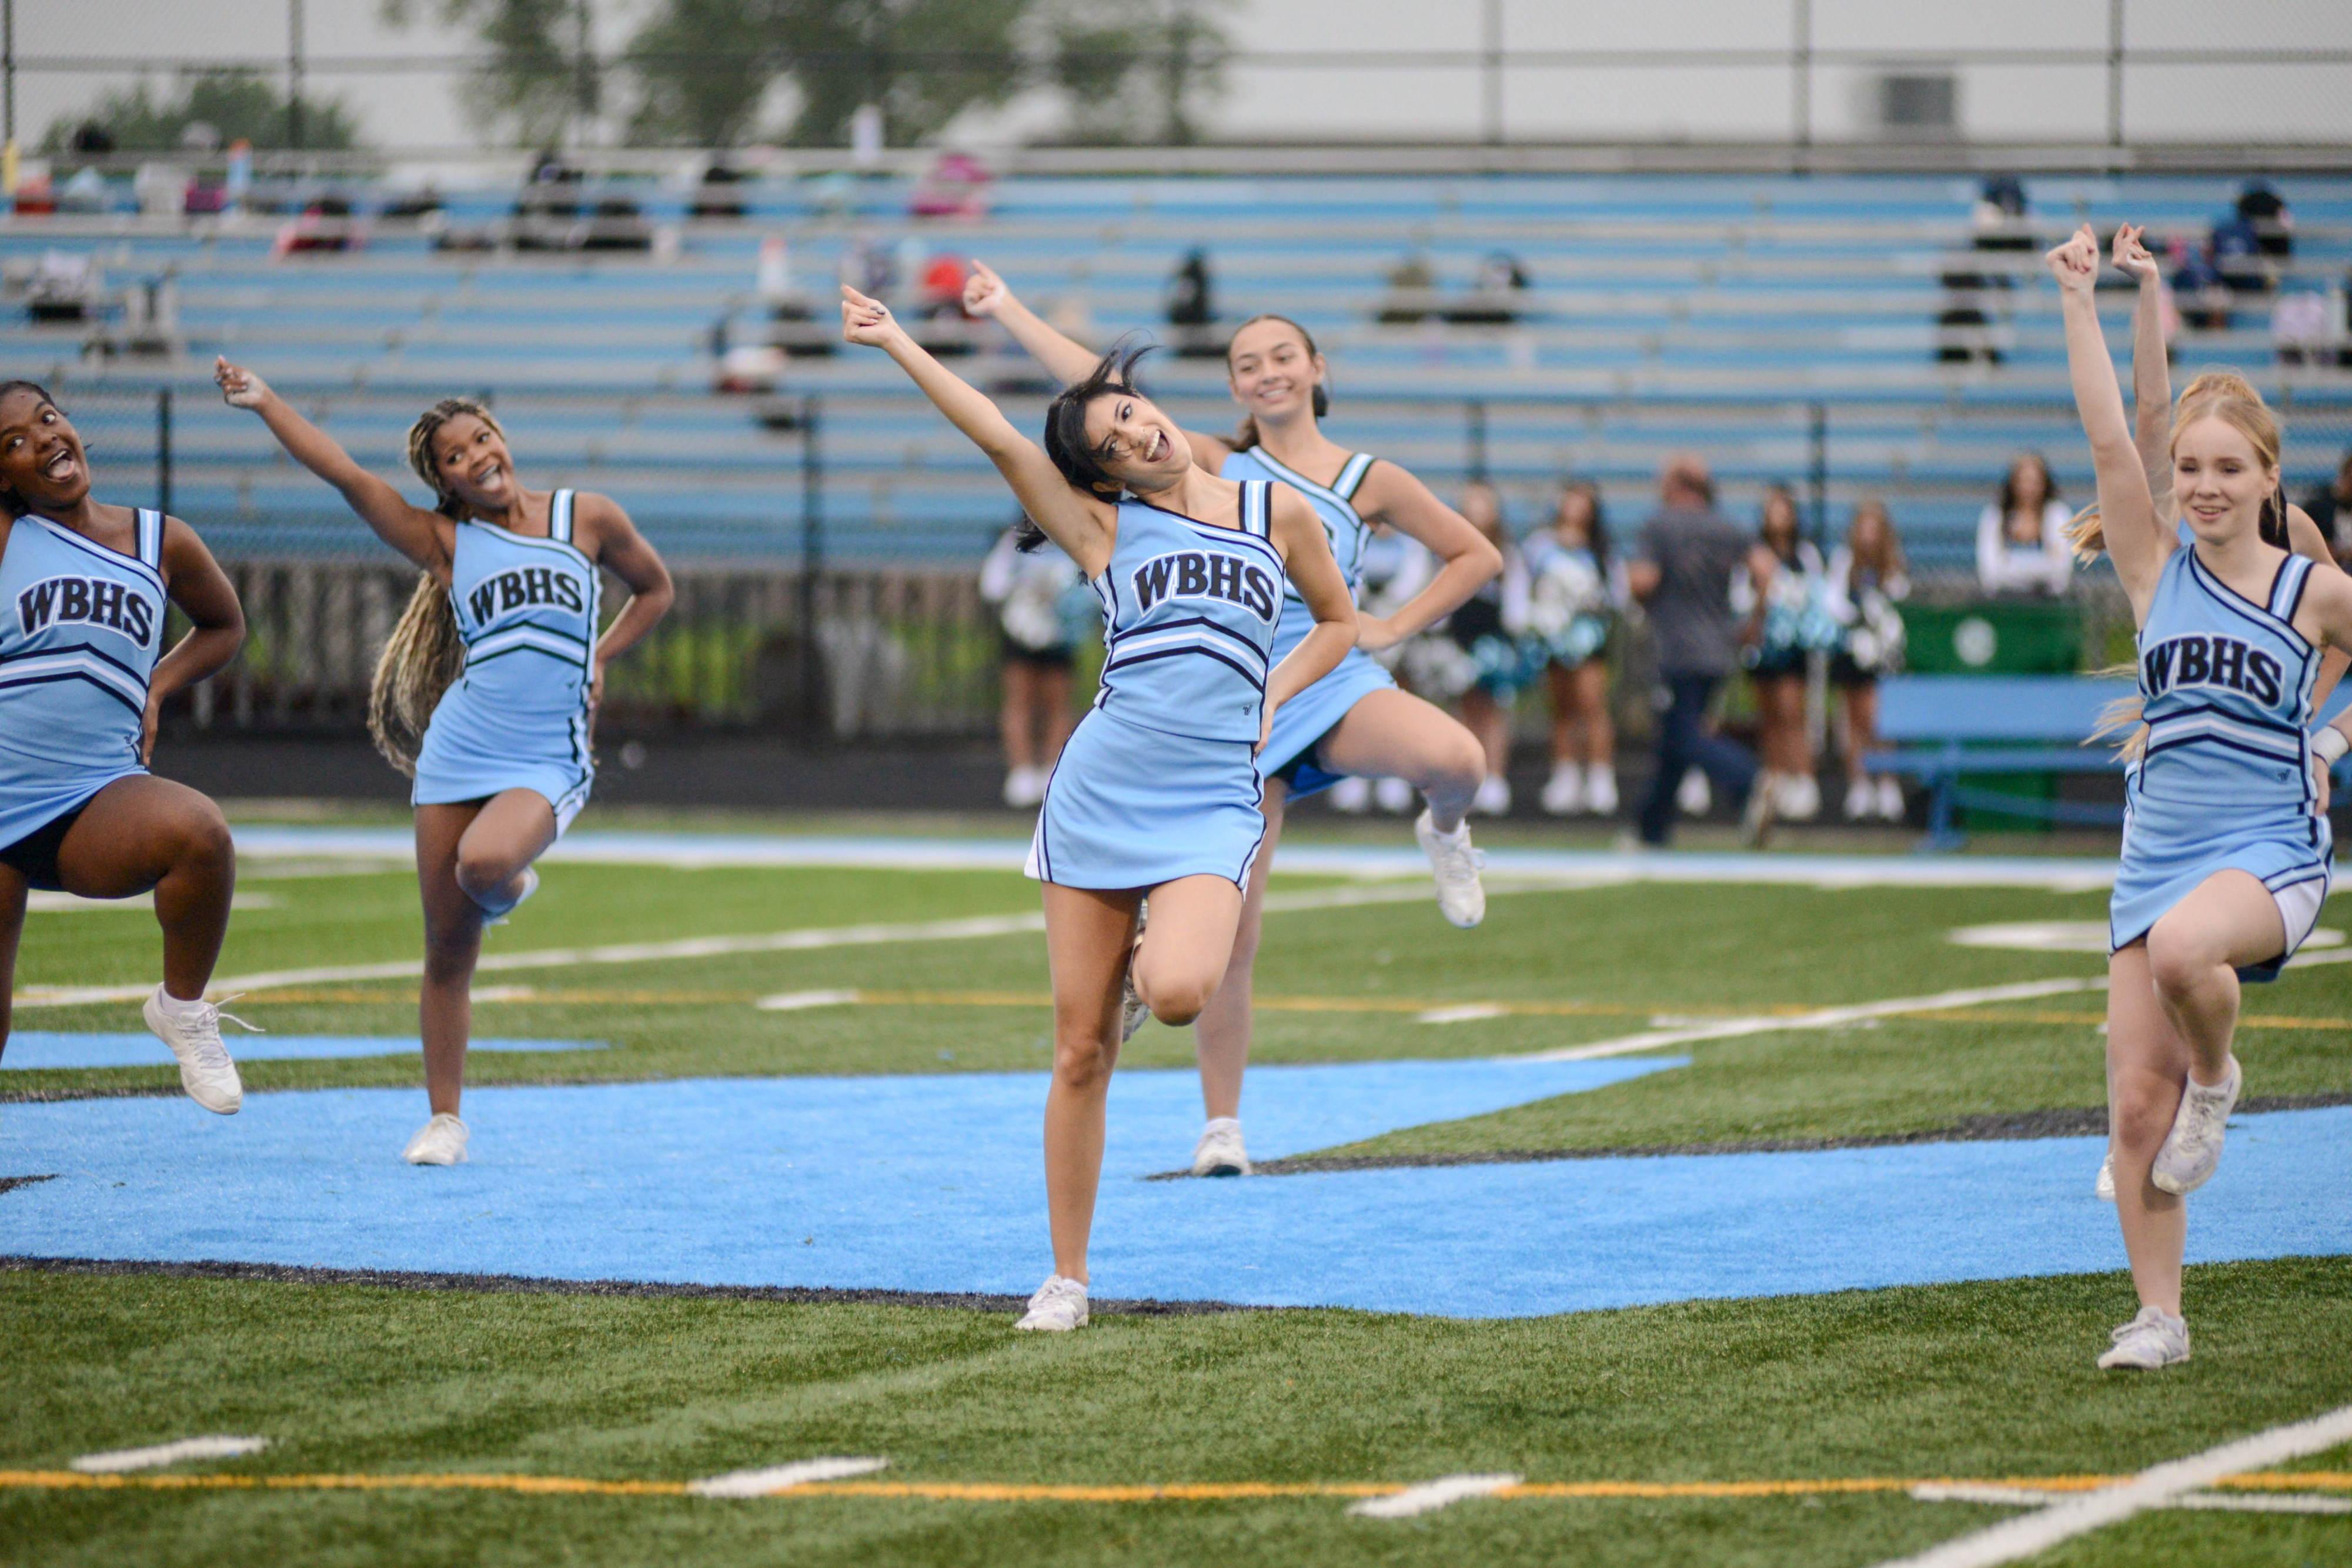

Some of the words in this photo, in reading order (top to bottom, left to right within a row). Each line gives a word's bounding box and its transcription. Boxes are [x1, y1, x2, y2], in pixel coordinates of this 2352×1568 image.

[18, 577, 153, 647] WBHS
[468, 567, 584, 628] WBHS
[1133, 552, 1276, 623] WBHS
[2143, 635, 2283, 708] WBHS
